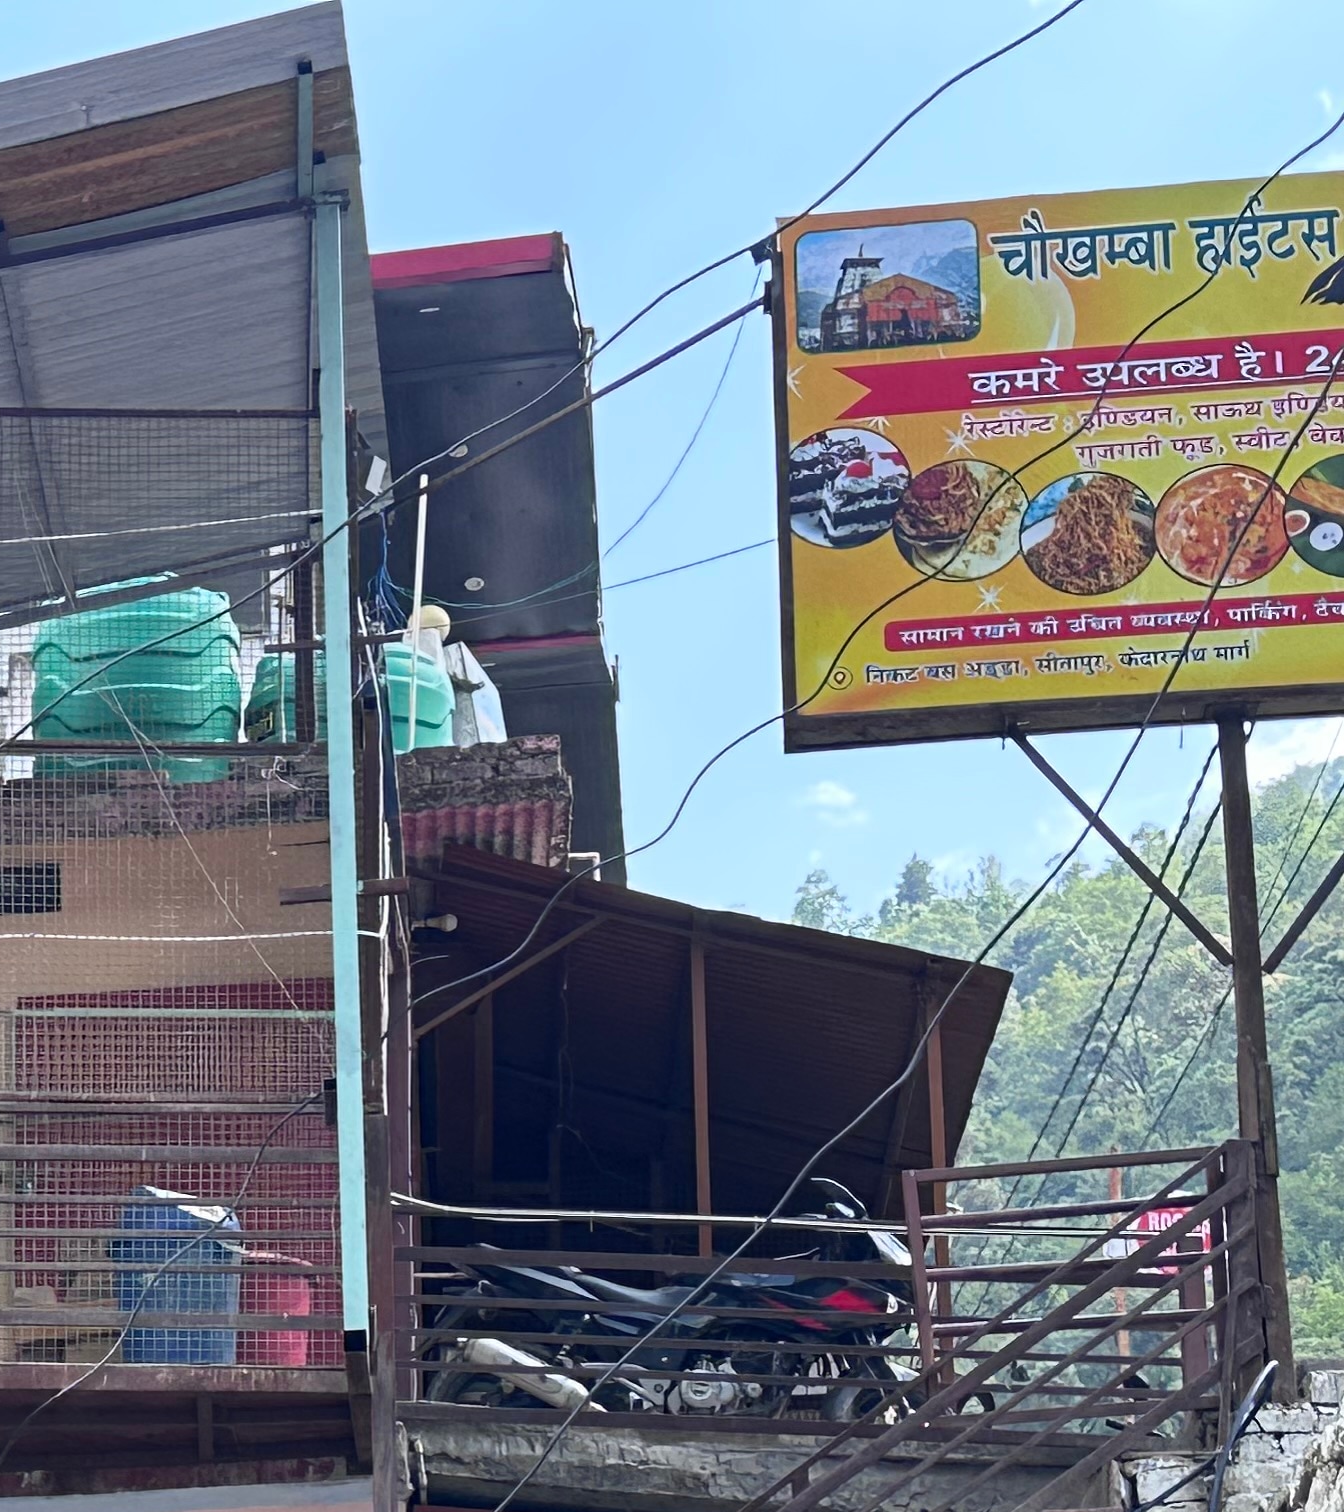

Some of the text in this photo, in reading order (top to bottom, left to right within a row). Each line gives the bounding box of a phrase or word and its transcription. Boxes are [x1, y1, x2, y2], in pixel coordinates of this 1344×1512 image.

[990, 209, 1176, 281] चौखम्बा
[968, 357, 1064, 395] कमरे
[1076, 354, 1223, 388] उपलब्ध
[1305, 345, 1344, 374] 2
[899, 626, 965, 645] सामान
[1028, 615, 1059, 635] की
[866, 664, 920, 684] निकट
[1213, 640, 1251, 661] मार्ग
